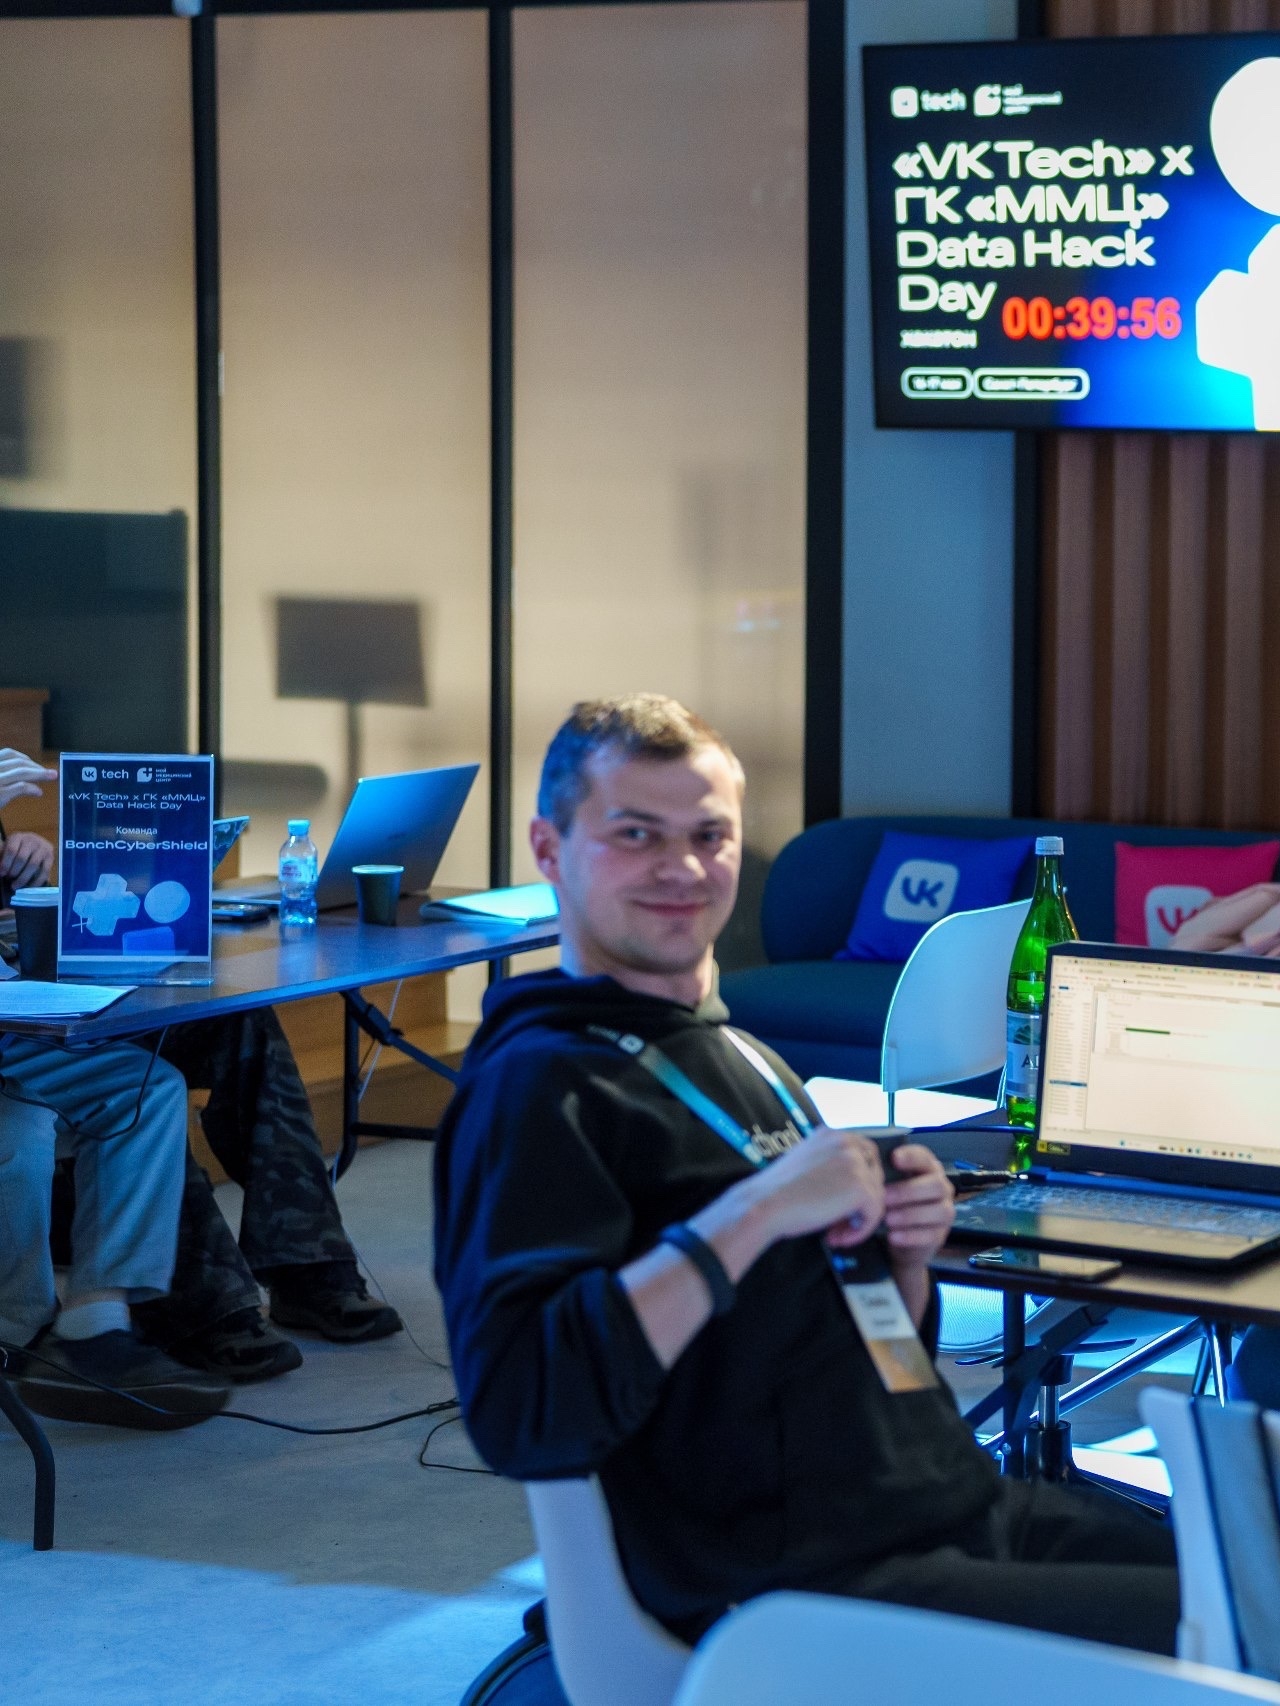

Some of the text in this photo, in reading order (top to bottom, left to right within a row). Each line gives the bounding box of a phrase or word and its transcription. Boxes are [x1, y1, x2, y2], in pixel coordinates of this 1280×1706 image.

[892, 141, 994, 180] «VK
[994, 138, 1156, 180] Tech»
[895, 183, 1170, 230] ГК «ММЦ»
[897, 228, 1156, 269] Data Hack
[898, 274, 997, 321] Day
[1002, 296, 1183, 341] 00:39:56
[101, 769, 129, 779] tech
[68, 792, 91, 801] «VK
[94, 792, 129, 801] Tech»
[143, 793, 158, 801] ГК
[161, 793, 206, 803] «ММЦ»
[96, 801, 182, 811] Data Hack Day
[65, 840, 208, 852] BonchCyberShield
[115, 826, 158, 836] Команда
[901, 877, 945, 909] VK
